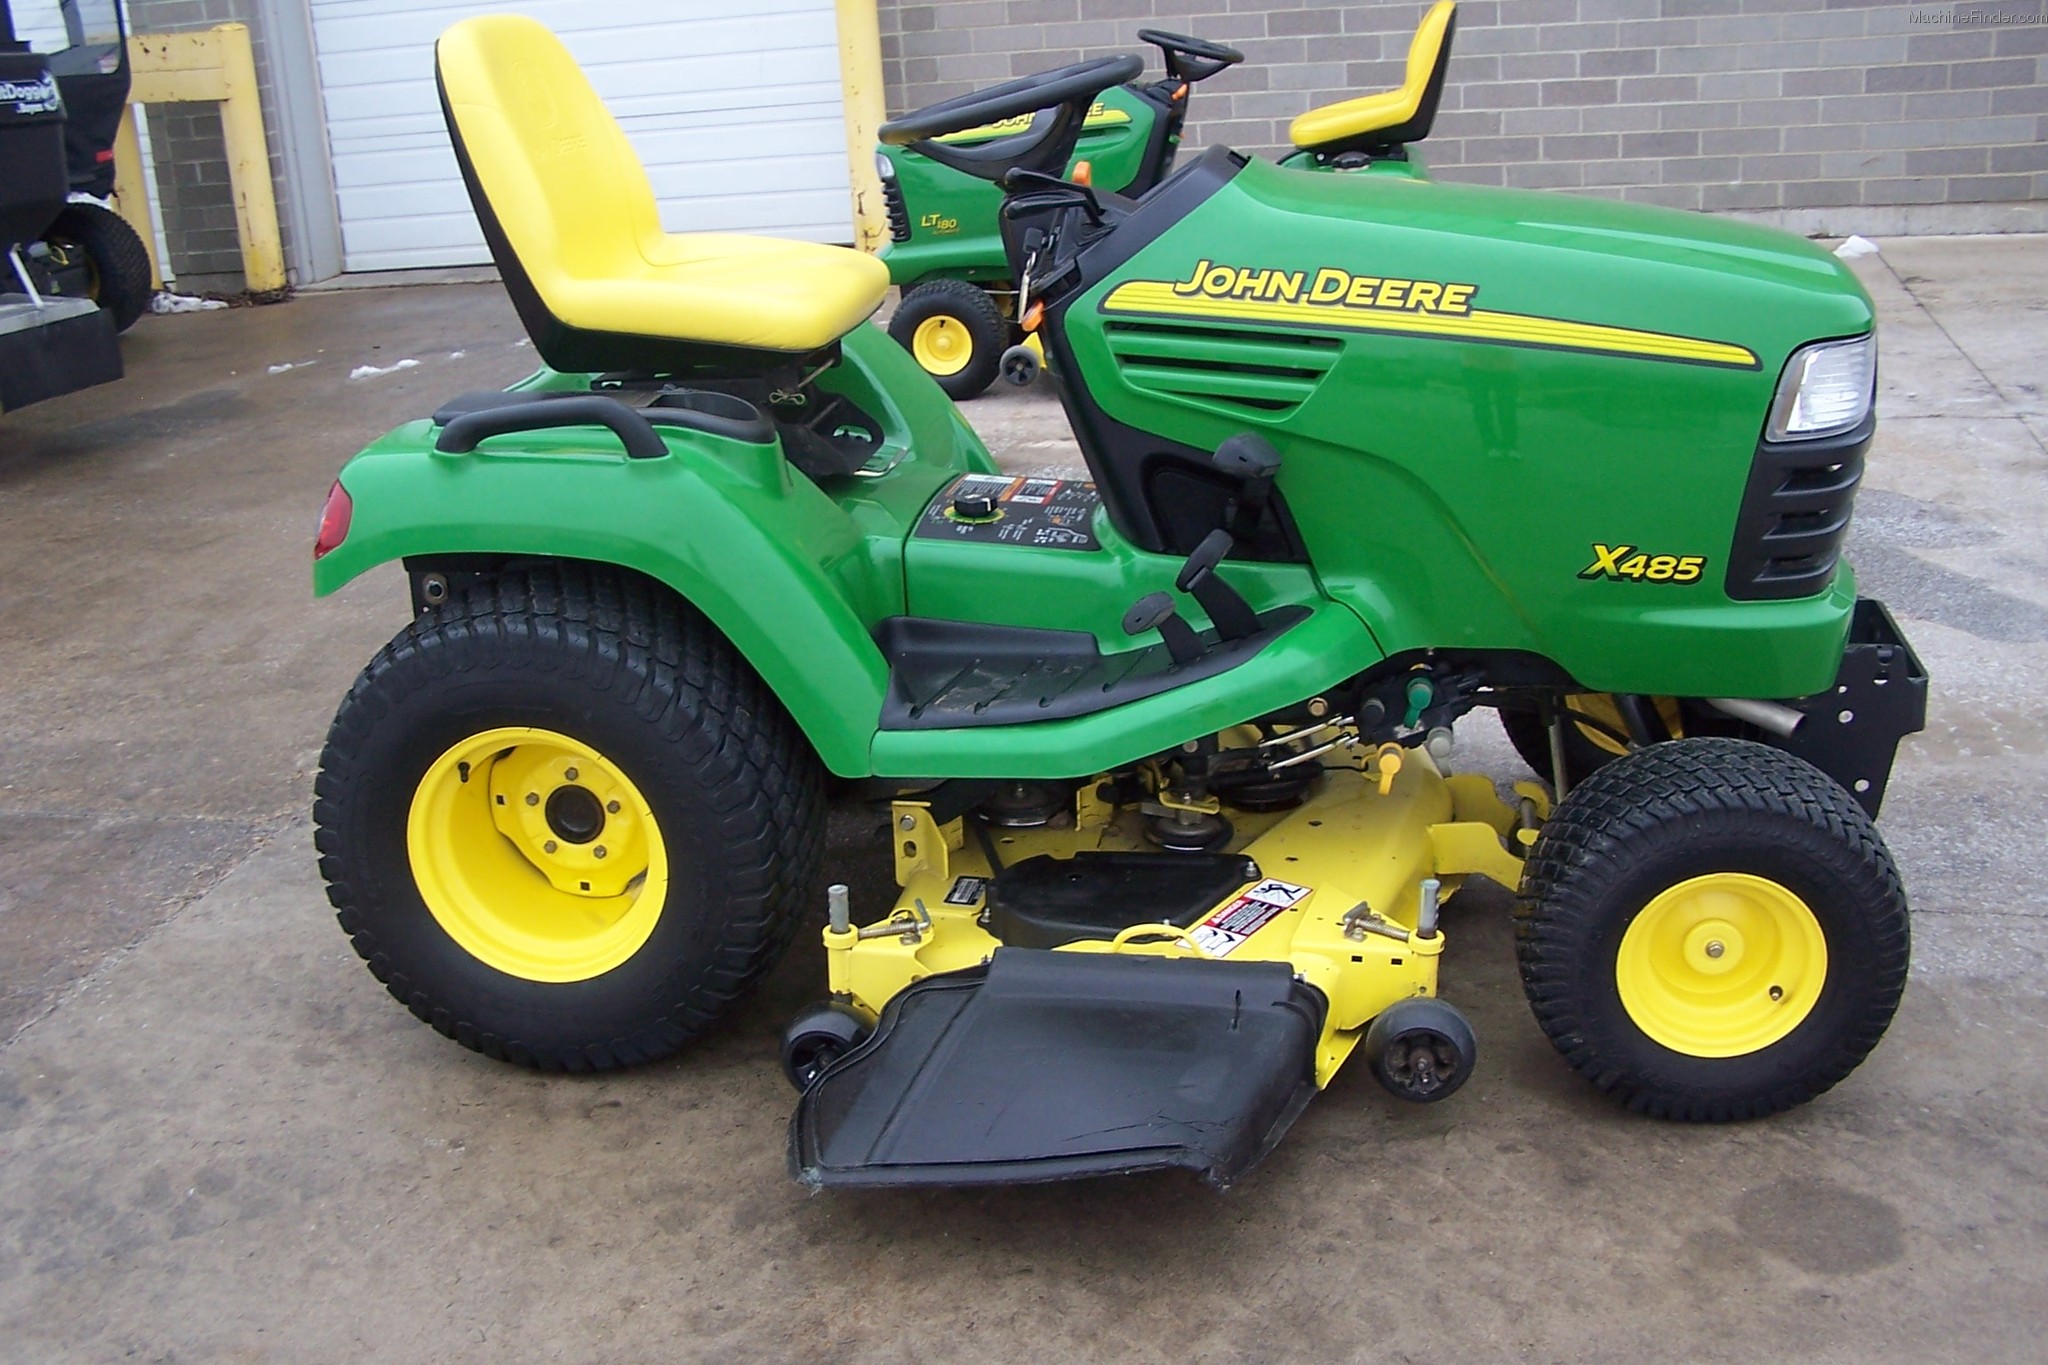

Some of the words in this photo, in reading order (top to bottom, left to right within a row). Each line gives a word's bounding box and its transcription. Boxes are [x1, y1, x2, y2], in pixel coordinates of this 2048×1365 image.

[920, 213, 958, 230] LT180
[1173, 260, 1304, 303] JOHN
[1306, 268, 1479, 316] DEERE
[1578, 544, 1707, 584] X485
